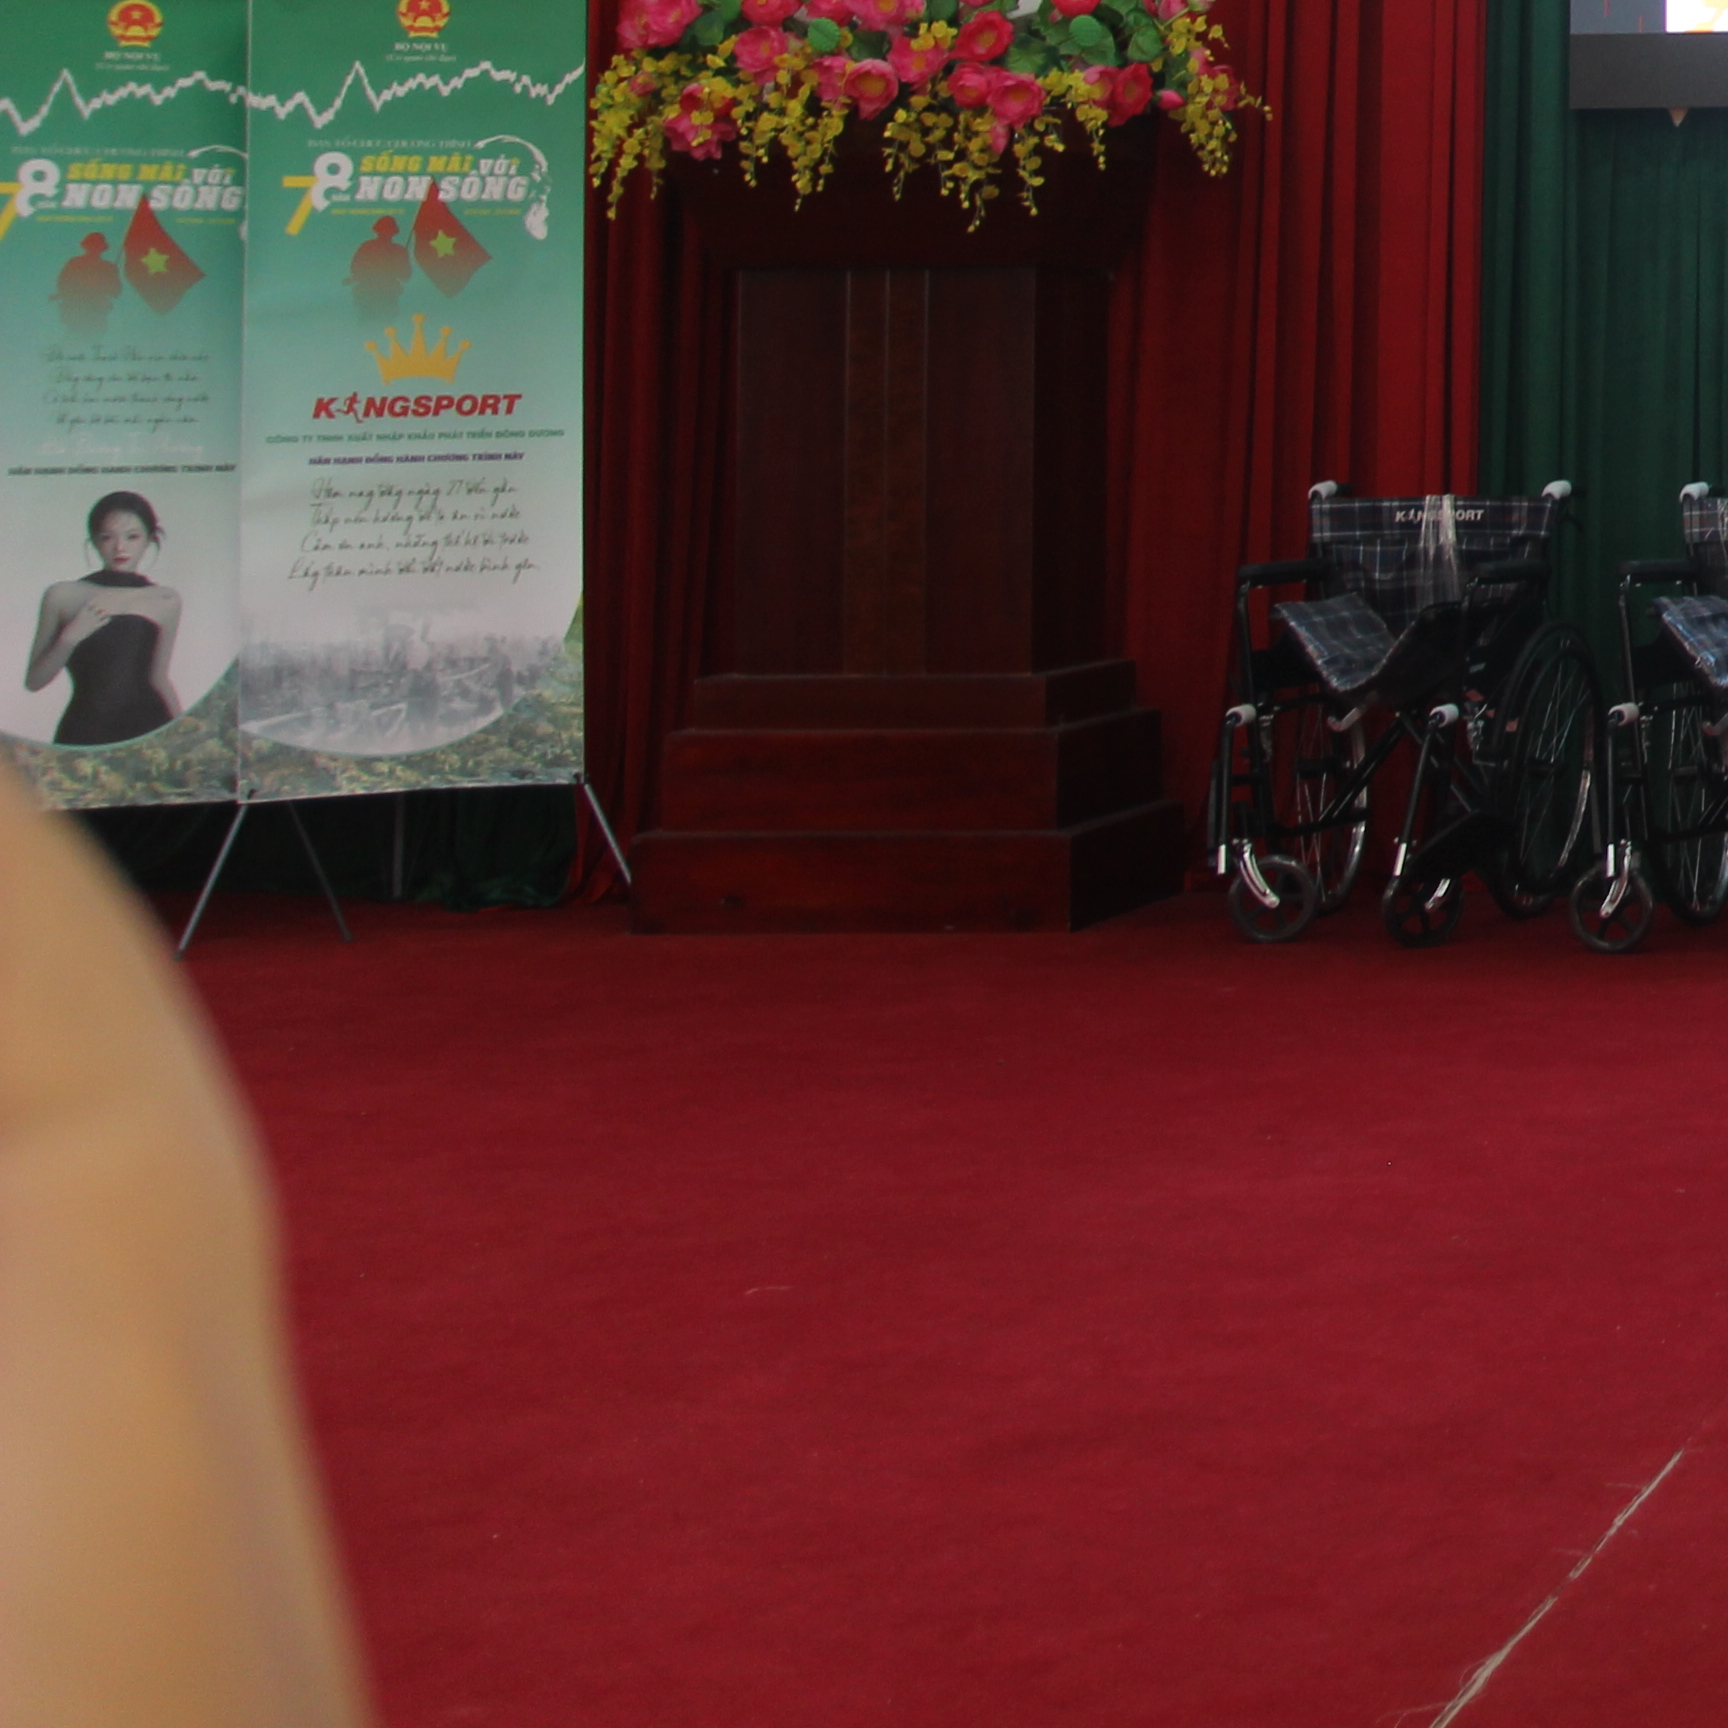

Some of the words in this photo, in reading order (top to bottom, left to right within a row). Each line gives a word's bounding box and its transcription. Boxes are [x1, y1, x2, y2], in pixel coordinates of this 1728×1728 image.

[67, 158, 134, 181] SỐNG
[360, 150, 422, 172] SỐNG
[427, 152, 474, 172] MÃI
[478, 154, 520, 176] VỚI
[61, 183, 143, 209] NON
[149, 177, 245, 210] SÔNG
[355, 175, 433, 200] NON
[438, 170, 529, 202] SÔNG
